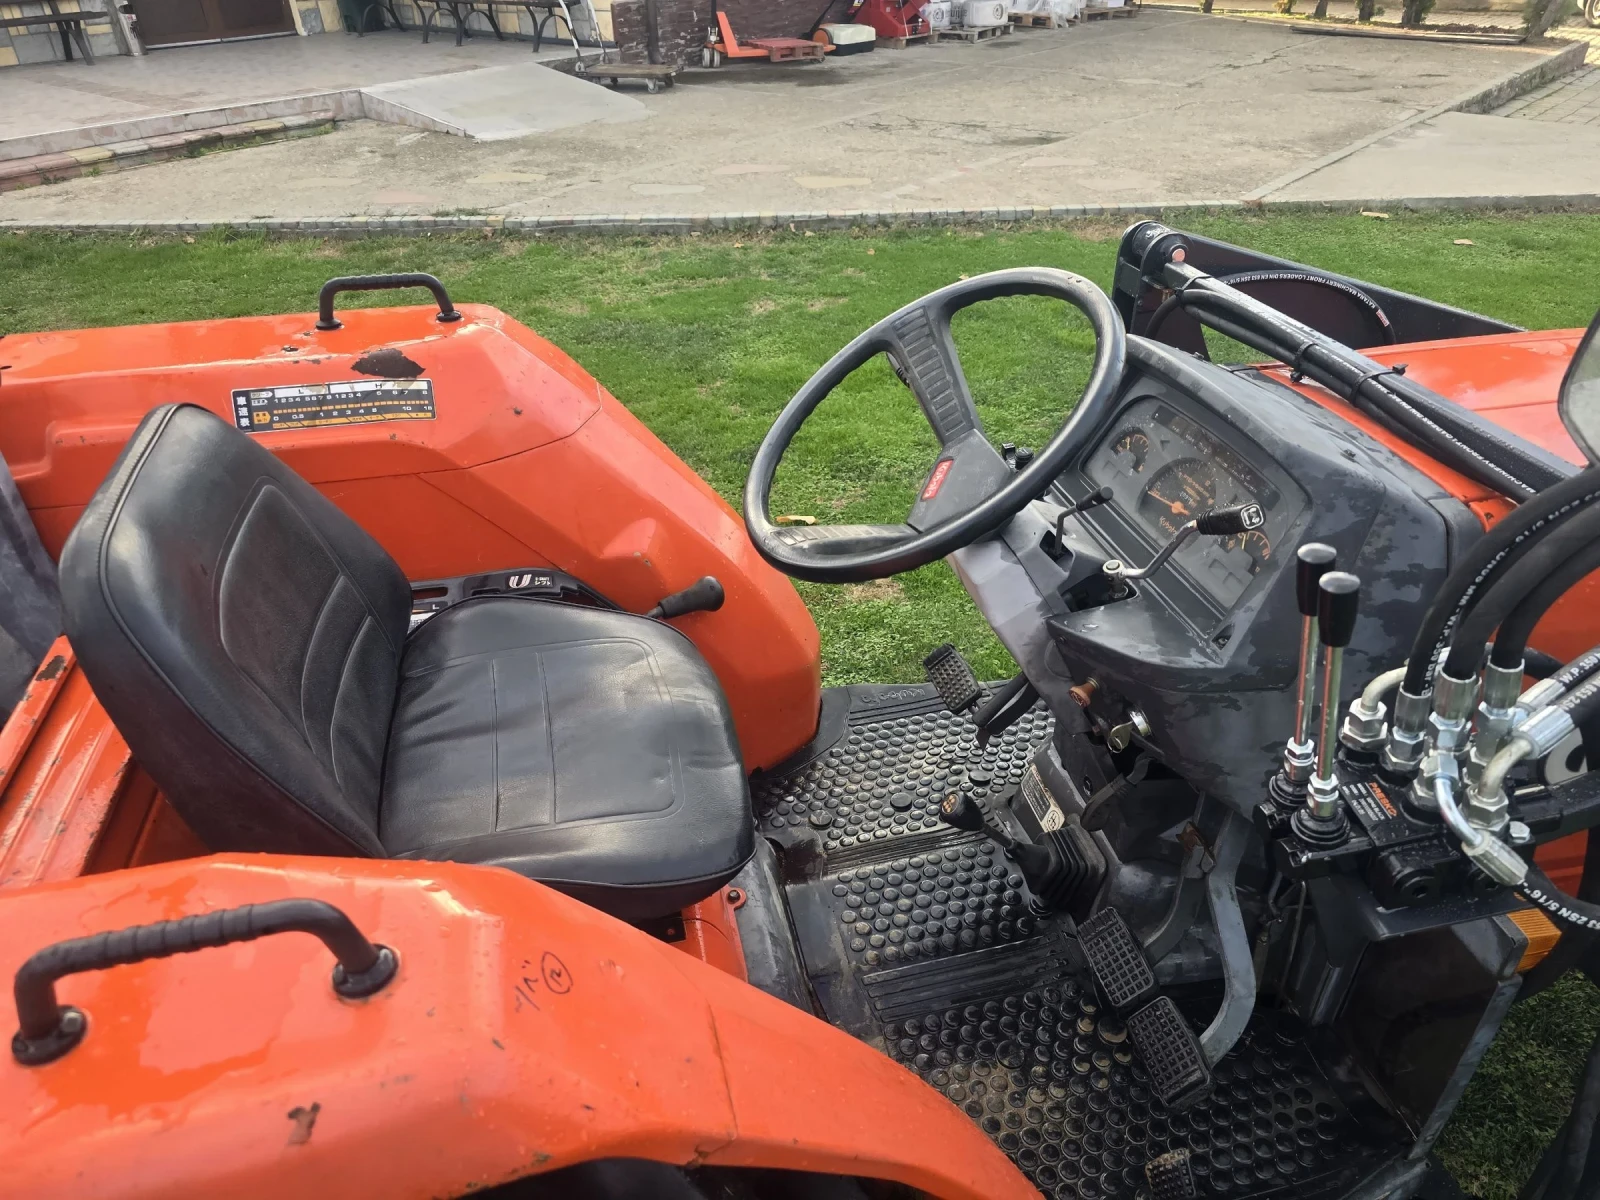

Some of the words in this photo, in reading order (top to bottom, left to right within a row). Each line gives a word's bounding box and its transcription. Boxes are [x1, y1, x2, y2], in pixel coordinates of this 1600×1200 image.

[1306, 275, 1326, 283] FRONT
[1325, 278, 1357, 295] MACHINERY
[1355, 290, 1376, 310] KATANA
[1454, 439, 1484, 461] FRONT
[1480, 457, 1537, 494] MACHINERY
[1558, 663, 1584, 685] W.P.
[1578, 653, 1598, 671] 350
[1556, 904, 1588, 926] 2SN
